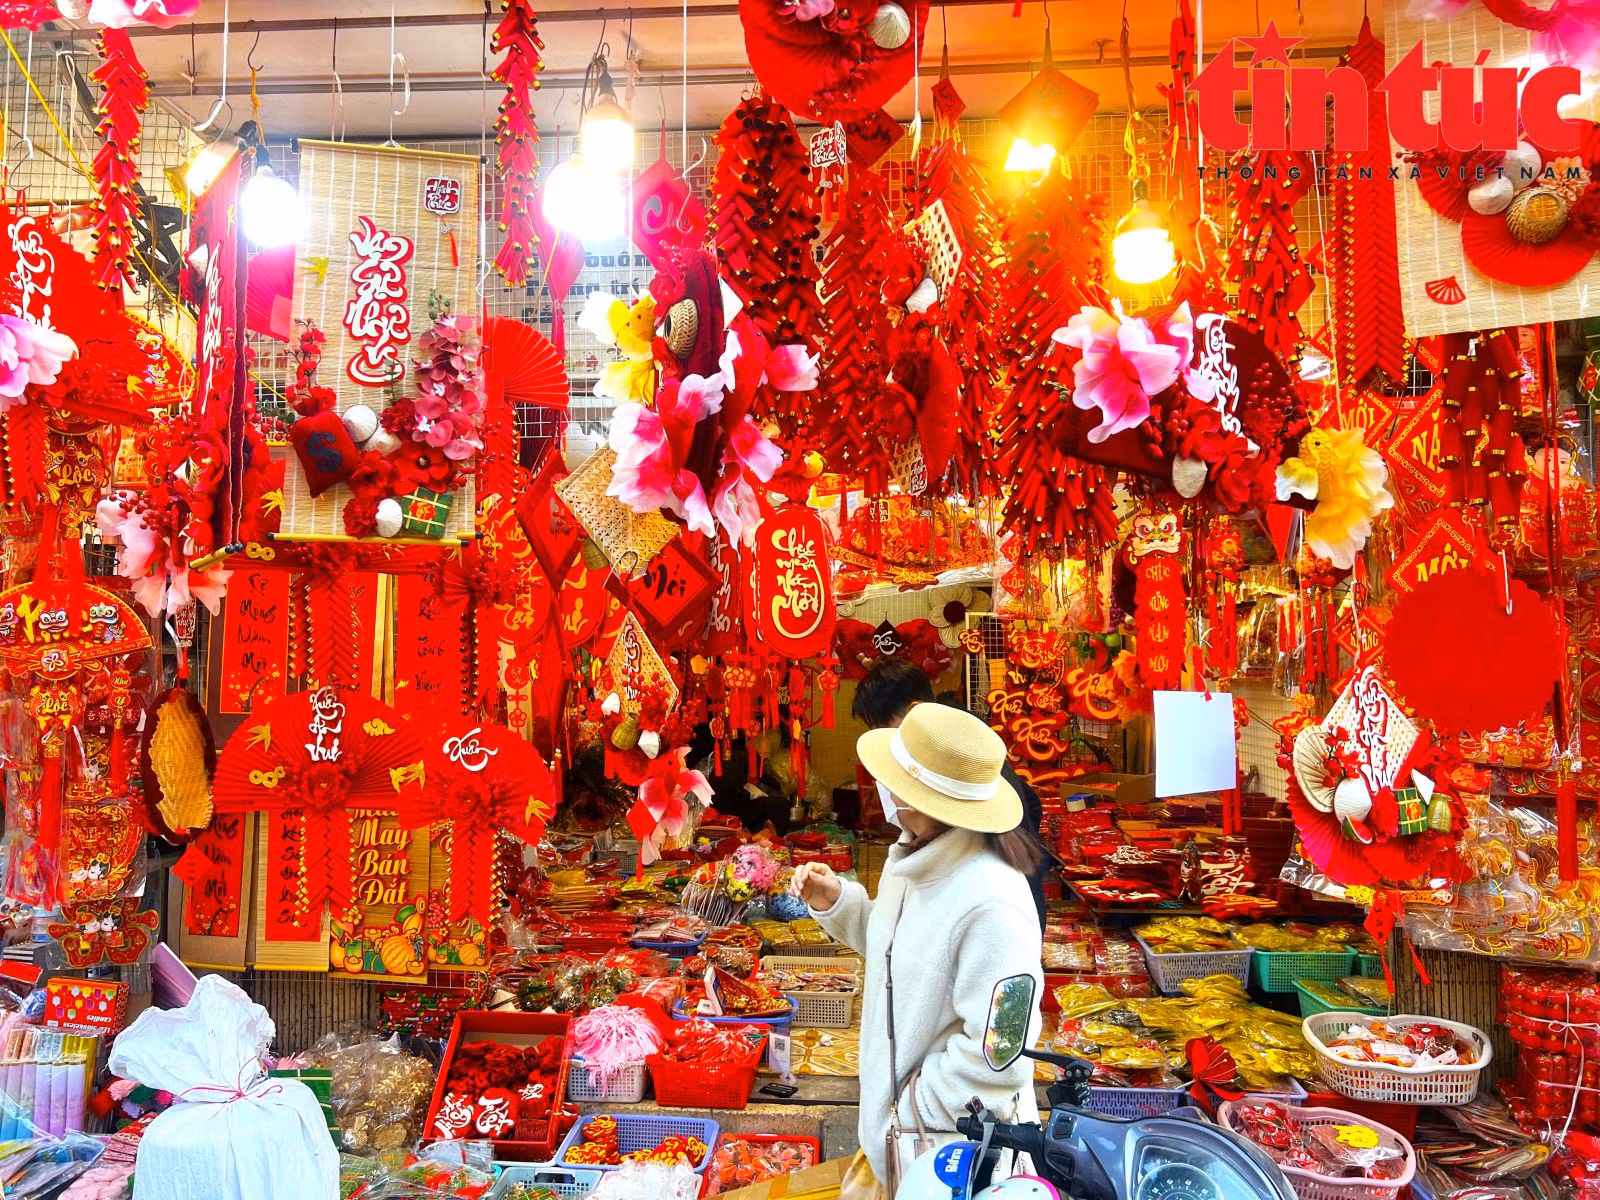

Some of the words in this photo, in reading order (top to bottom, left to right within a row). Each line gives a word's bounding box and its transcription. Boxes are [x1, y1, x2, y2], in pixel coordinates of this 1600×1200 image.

[59, 463, 94, 488] Lộc
[42, 698, 68, 712] Lộc
[442, 727, 499, 772] Xuân
[354, 819, 410, 850] May
[357, 850, 410, 878] Bán
[358, 879, 407, 907] Đắt
